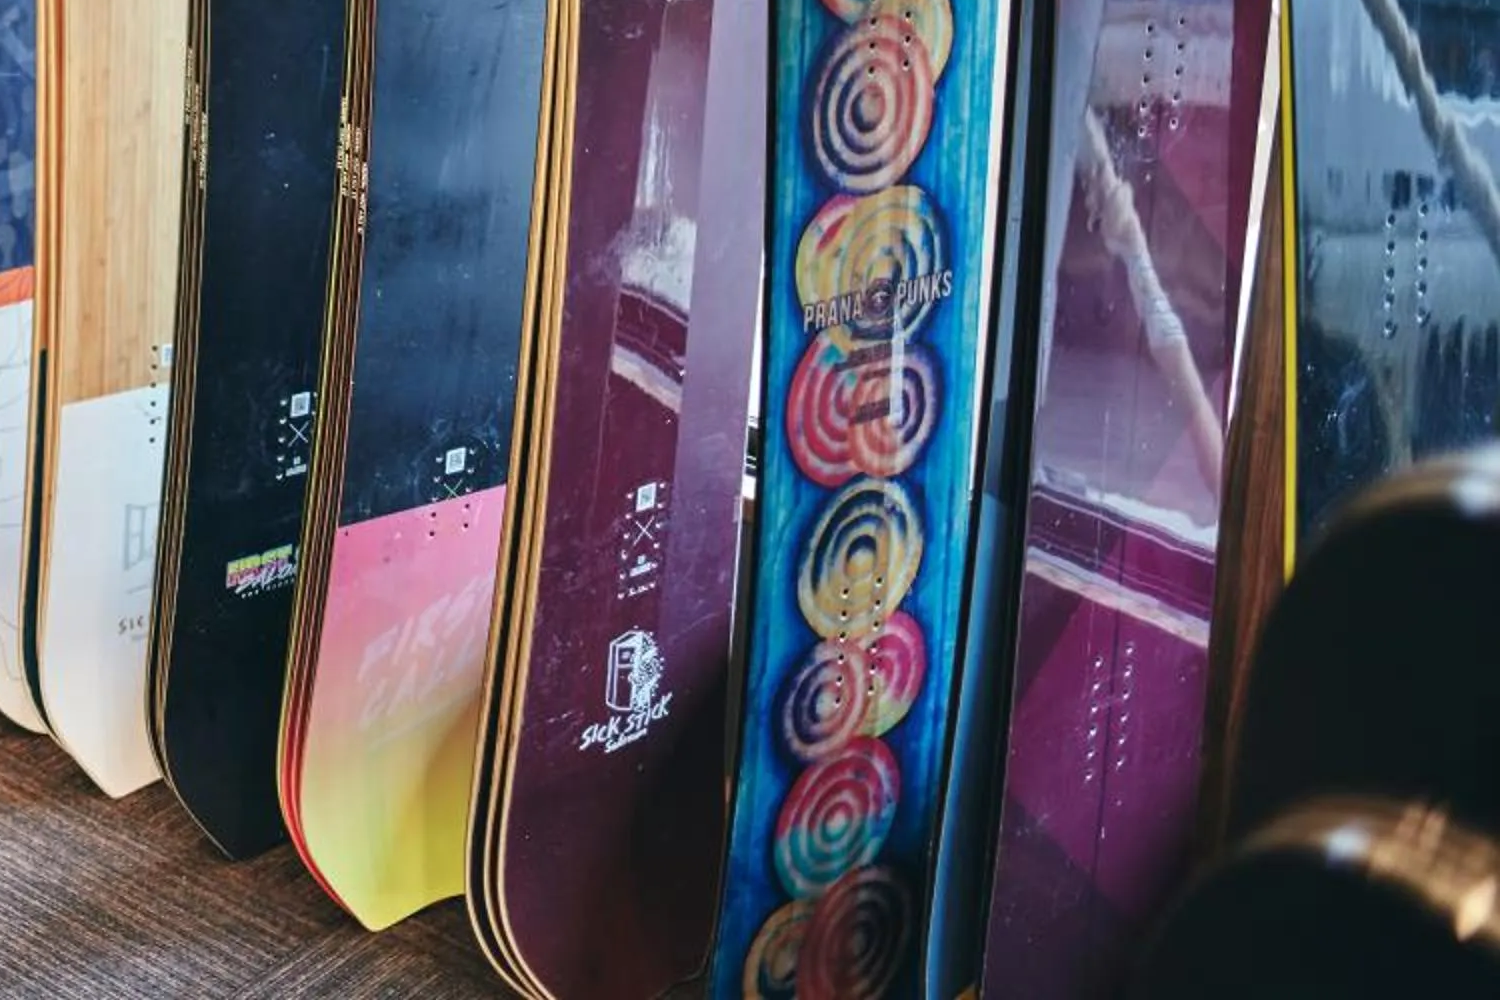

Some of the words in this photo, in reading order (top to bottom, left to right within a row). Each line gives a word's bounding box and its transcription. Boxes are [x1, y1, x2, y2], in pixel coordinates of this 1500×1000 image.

[804, 292, 864, 333] PRANA
[895, 269, 953, 306] PUNKS
[579, 715, 622, 751] SICK
[623, 692, 674, 734] STICK
